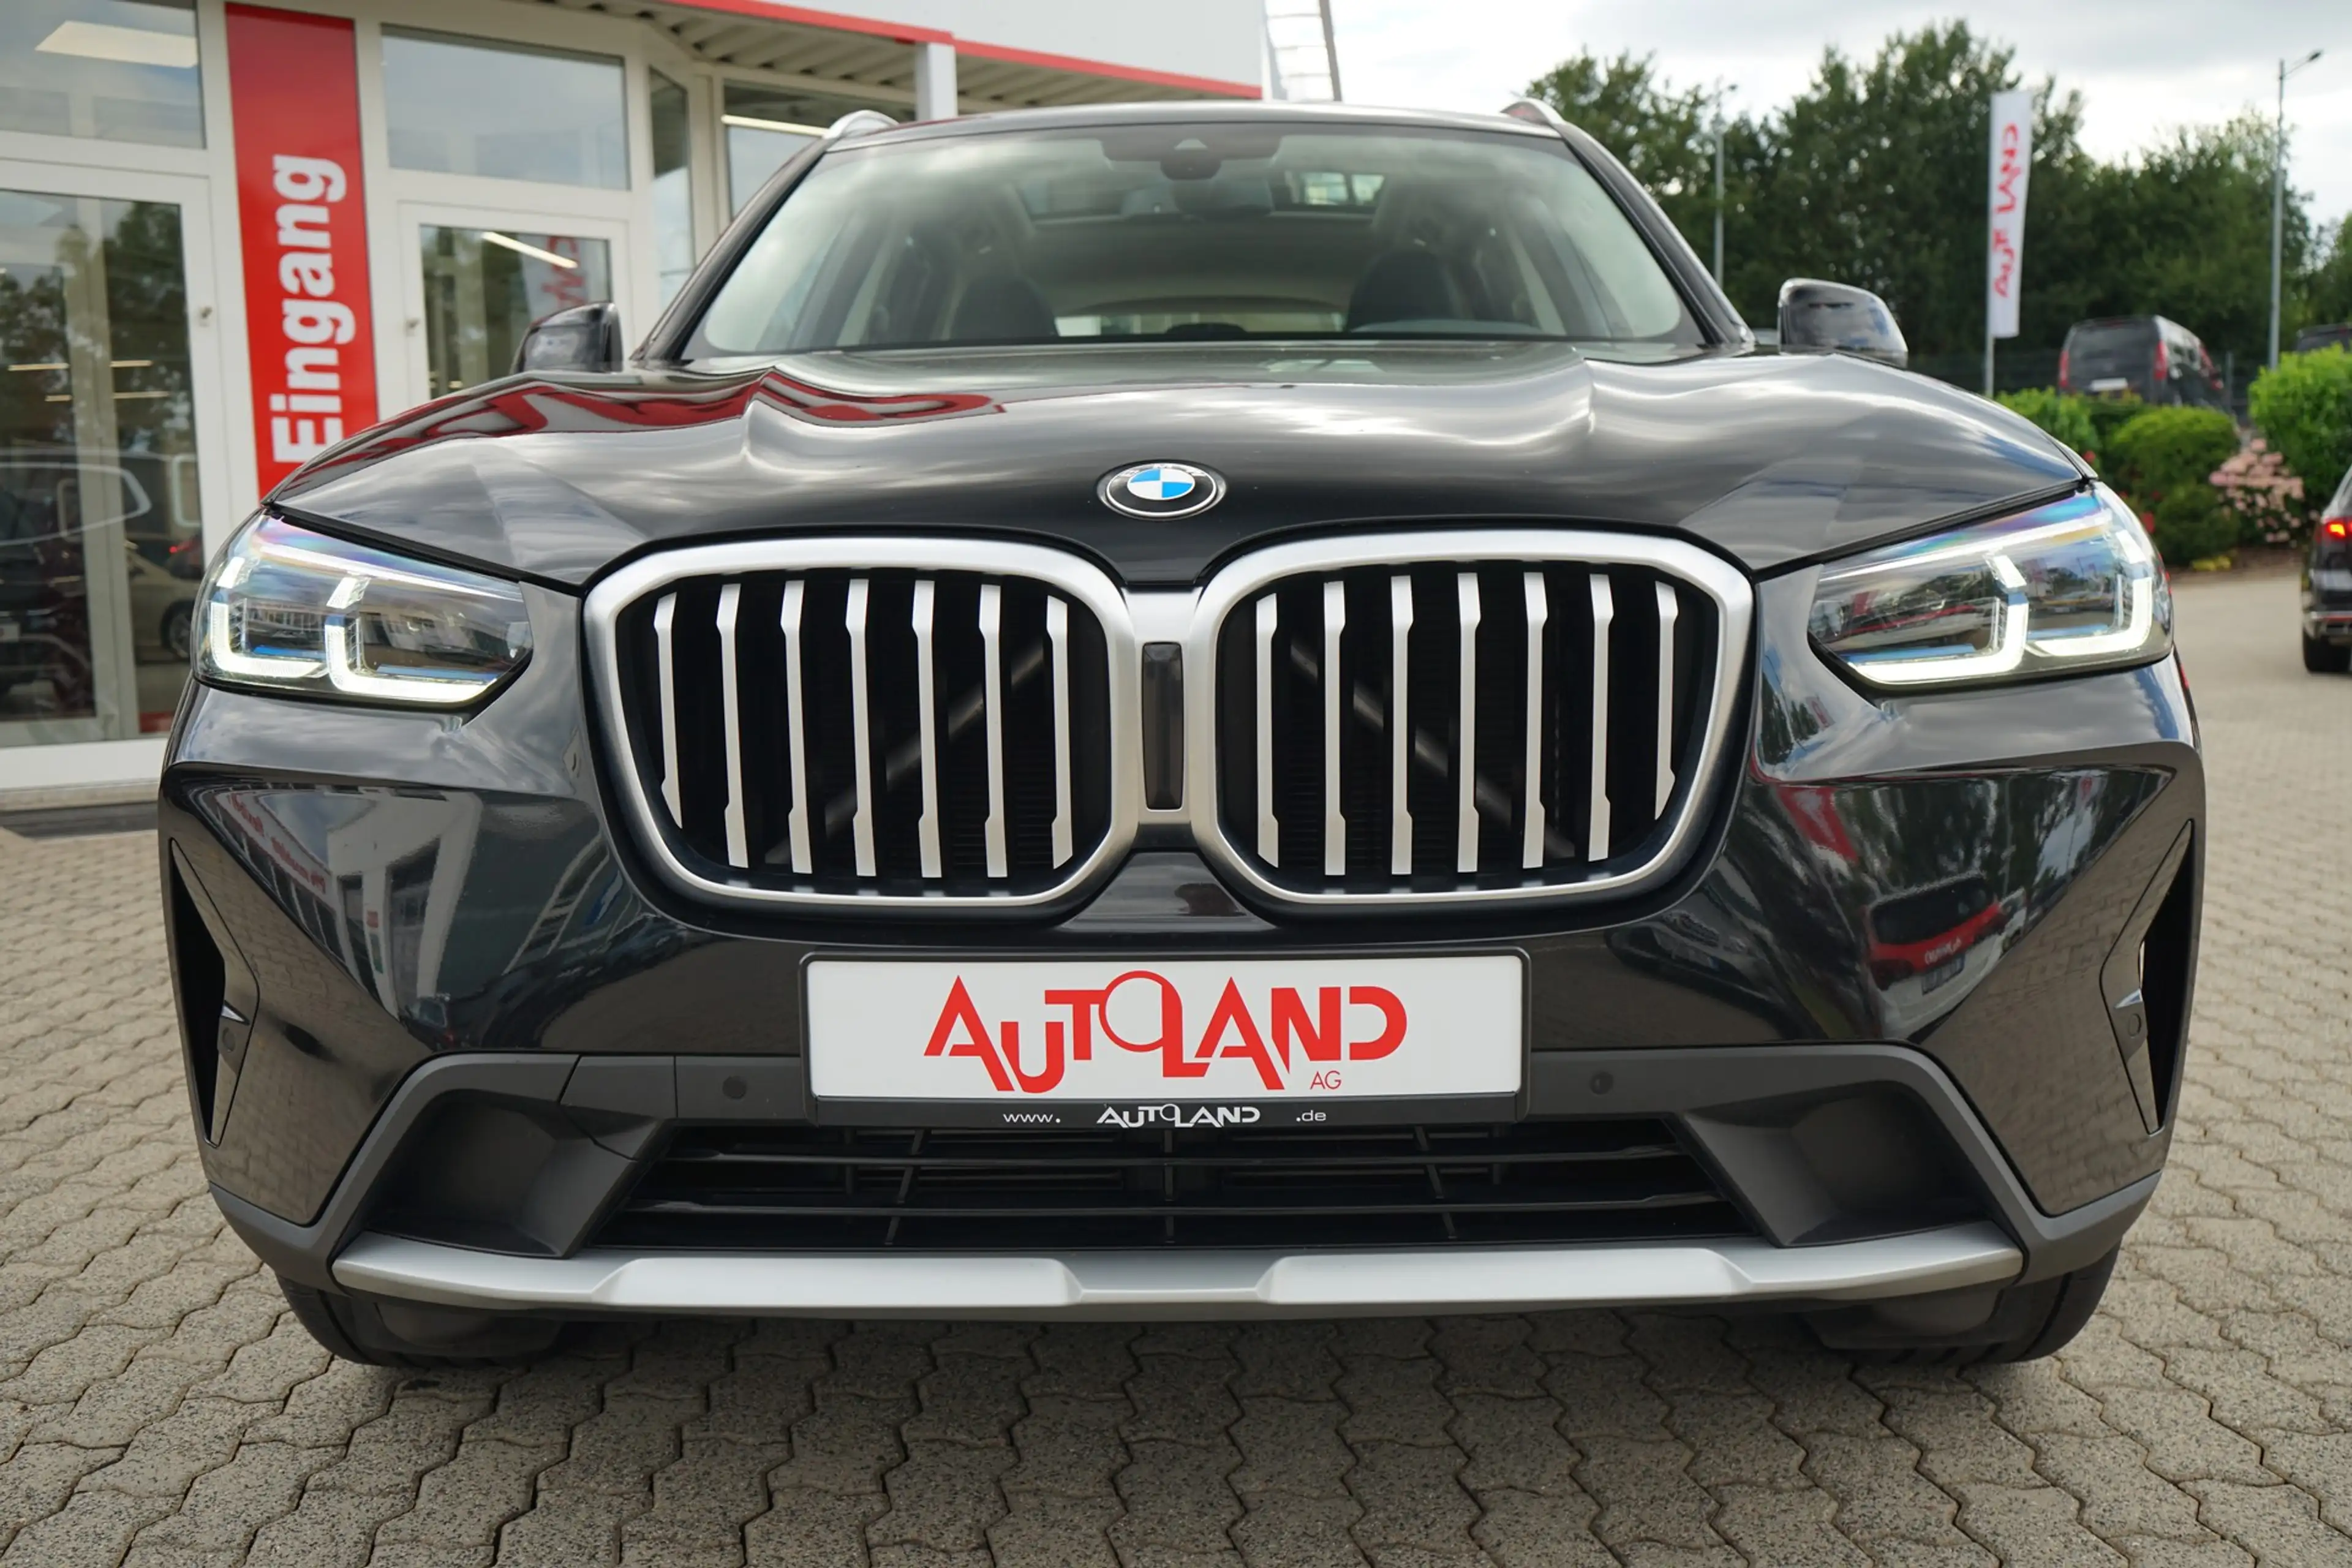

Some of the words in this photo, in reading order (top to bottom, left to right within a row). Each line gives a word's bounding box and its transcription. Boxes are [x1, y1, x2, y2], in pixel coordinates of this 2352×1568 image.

[1992, 123, 2021, 298] AUTLAND
[270, 154, 355, 462] Eingang
[924, 970, 1408, 1093] AUTOLAND
[1310, 1070, 1342, 1090] AG
[1096, 1104, 1261, 1128] AUTOLAND
